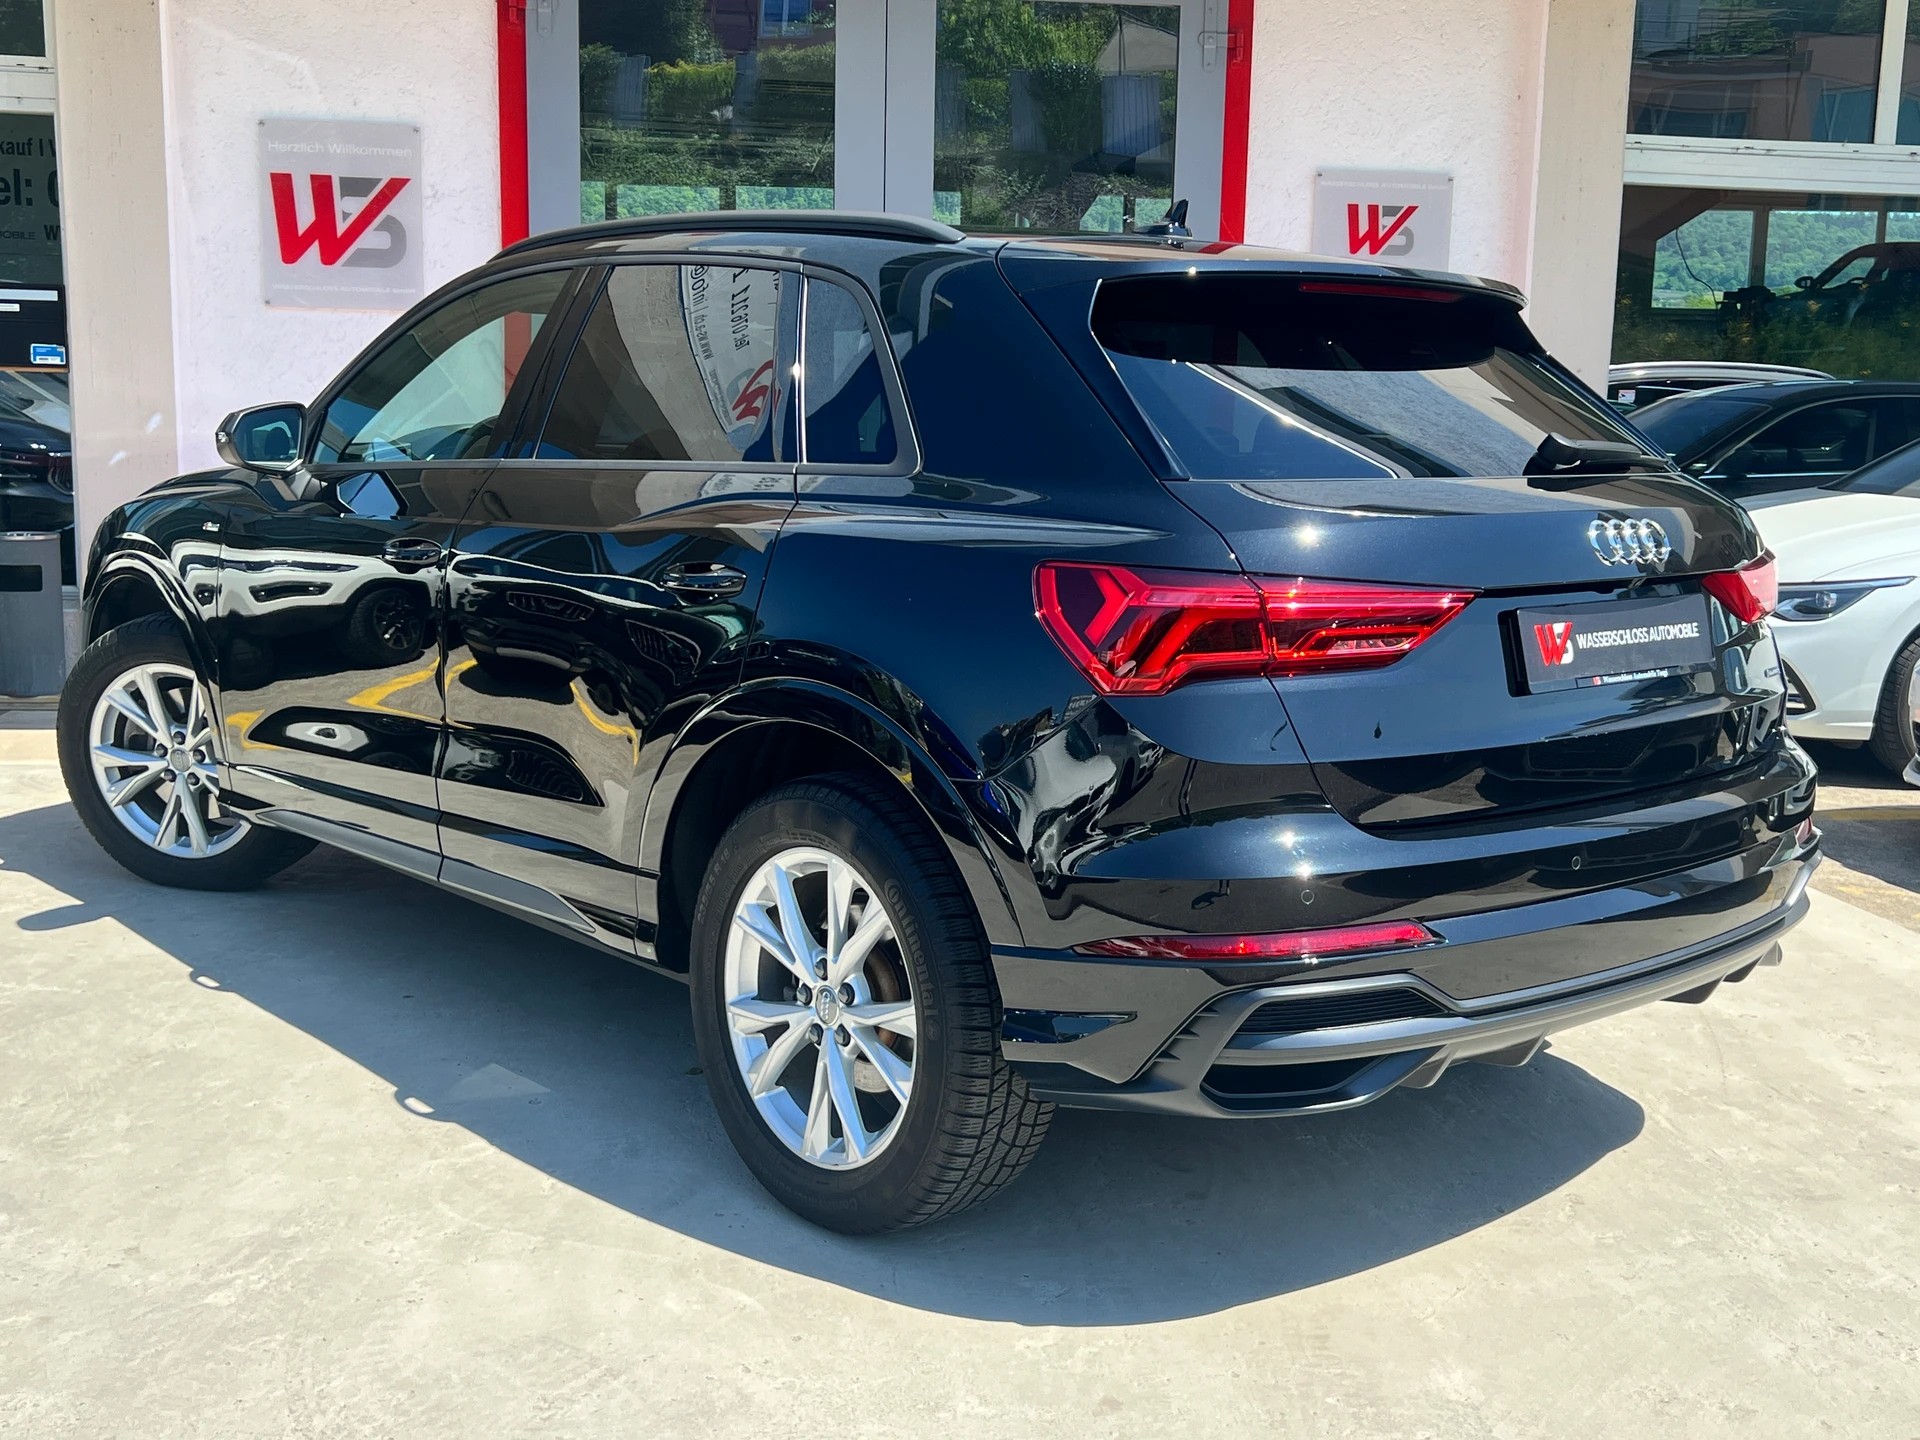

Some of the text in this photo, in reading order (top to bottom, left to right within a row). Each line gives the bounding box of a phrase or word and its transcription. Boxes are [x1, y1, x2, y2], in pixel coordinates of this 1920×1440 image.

[267, 141, 413, 158] Herzlich Willkommen
[1575, 628, 1649, 650] WASSERSCHLOSS
[1649, 622, 1700, 641] AUTOMOBILE
